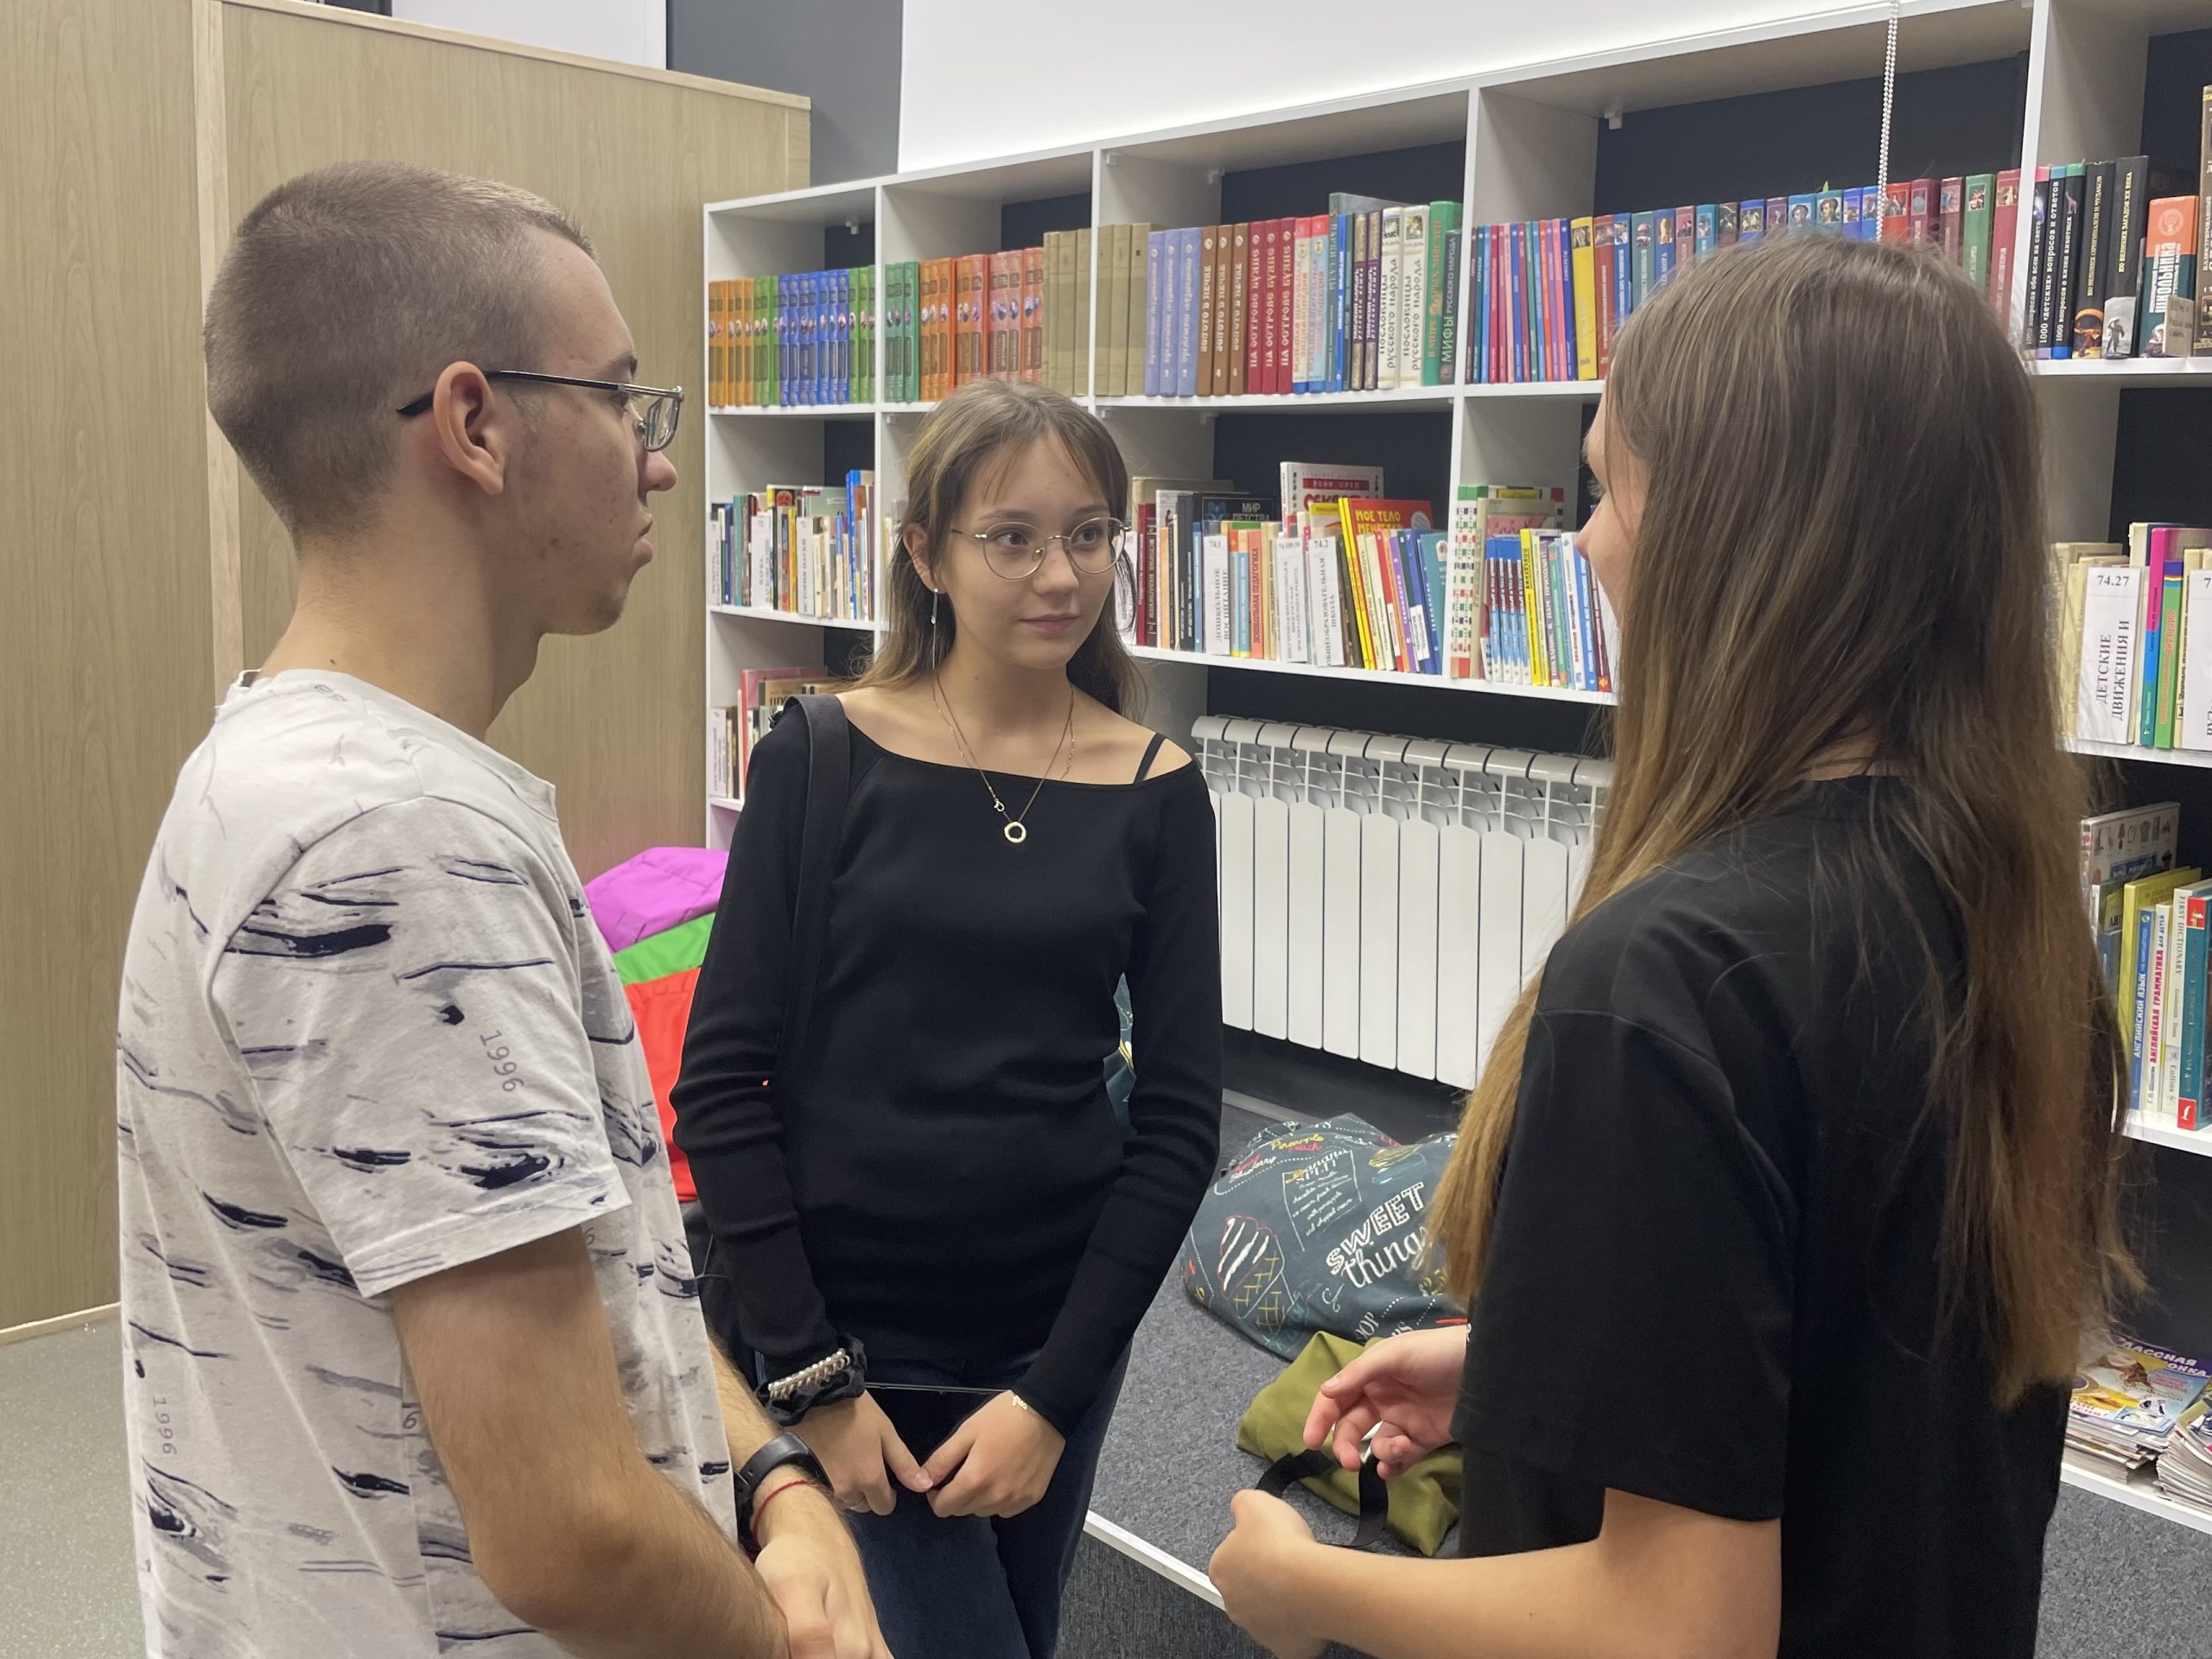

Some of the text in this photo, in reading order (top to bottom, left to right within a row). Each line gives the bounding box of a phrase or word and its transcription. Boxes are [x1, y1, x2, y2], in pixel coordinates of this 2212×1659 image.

[2050, 181, 2059, 219] ответов
[2046, 229, 2056, 272] вопросов
[2058, 287, 2067, 322] вопросов
[1442, 316, 1454, 362] МИФЫ
[2040, 323, 2049, 343] 1000
[1242, 503, 1261, 513] МИР
[1377, 511, 1401, 521] ТЕЛО
[1313, 539, 1329, 549] 74.2
[2097, 575, 2130, 587] 74.27
[1319, 557, 1332, 666] ОБЩЕОБРАЗОВАТЕЛЬНАЯ
[2096, 634, 2112, 705] ДЕТСКИЕ
[2111, 620, 2130, 721] ДВИЖЕНИЯ И
[2175, 921, 2185, 975] DICTIONARY
[2137, 973, 2146, 998] ЯЗЫК
[2152, 950, 2164, 1006] ГРАММАТИКА
[2133, 1000, 2145, 1058] АНГЛИЙСКИЙ
[2149, 1008, 2160, 1064] АНГЛИЙСКАЯ
[479, 1028, 524, 1094] 1996
[2168, 1065, 2177, 1092] Collins
[1326, 1181, 1425, 1275] SWEET
[2121, 1338, 2198, 1367] ЛАССНАЯ
[2166, 1363, 2209, 1377] ОНКА
[151, 1395, 177, 1457] 1996
